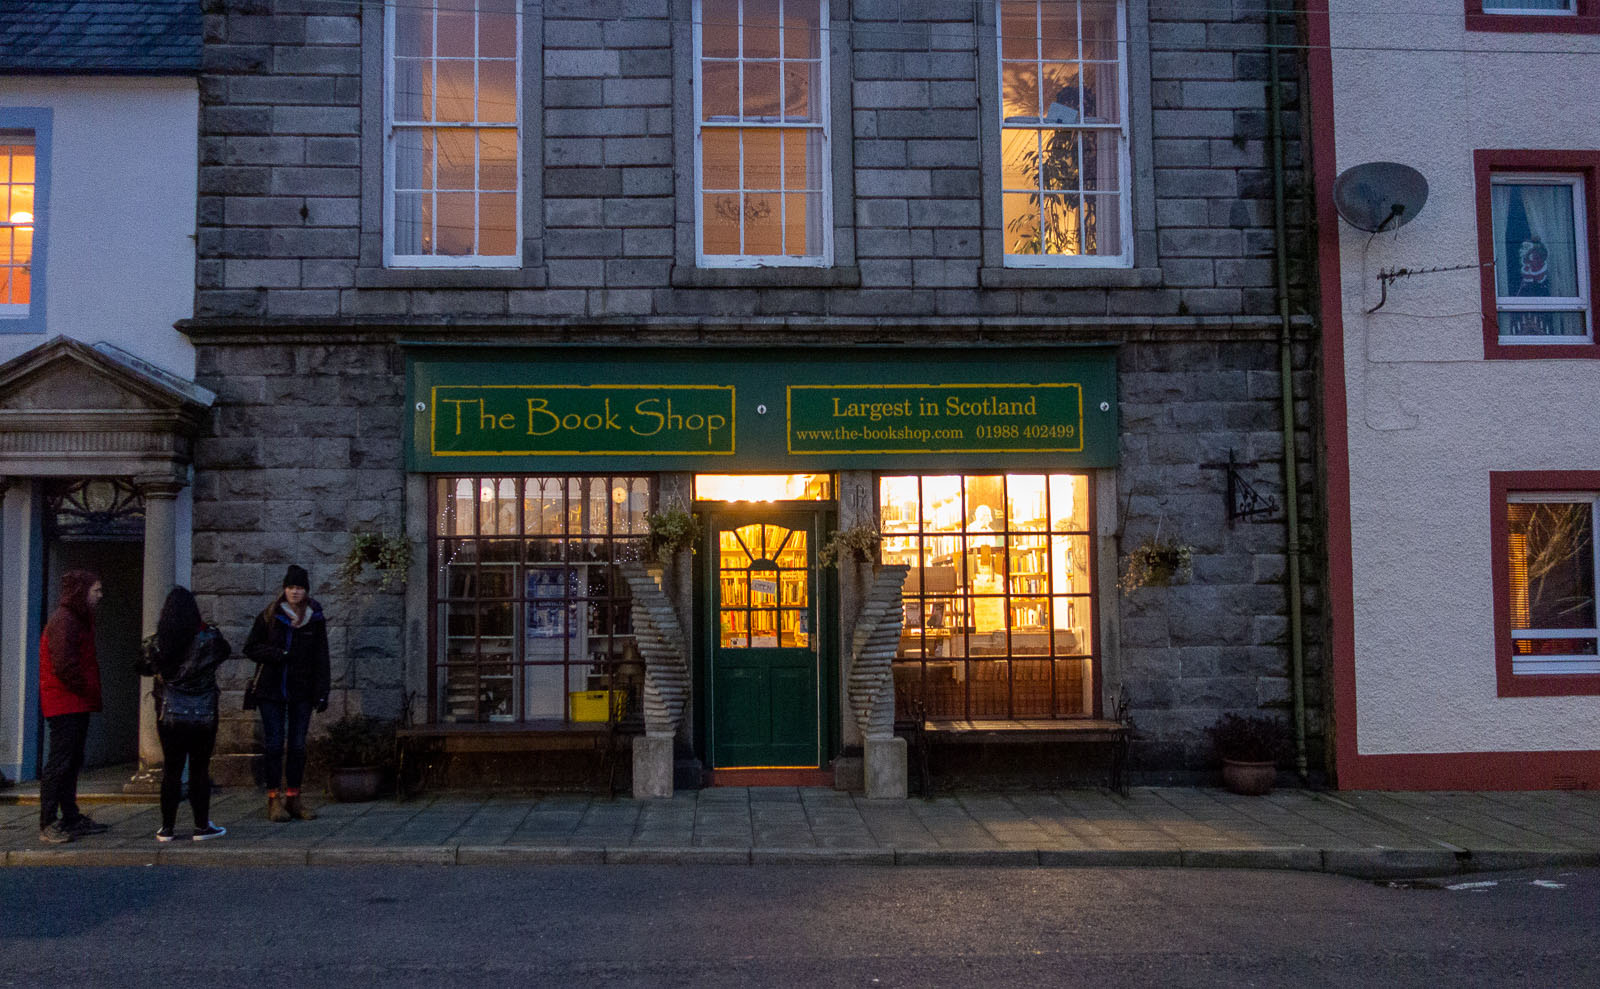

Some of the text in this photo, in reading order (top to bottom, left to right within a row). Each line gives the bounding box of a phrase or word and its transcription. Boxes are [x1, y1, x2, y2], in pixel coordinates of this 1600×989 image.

[832, 396, 1037, 421] Largest in Scotland
[442, 398, 726, 445] The Book Shop
[796, 424, 1074, 442] www.the-bookshop.com 01988 402499
